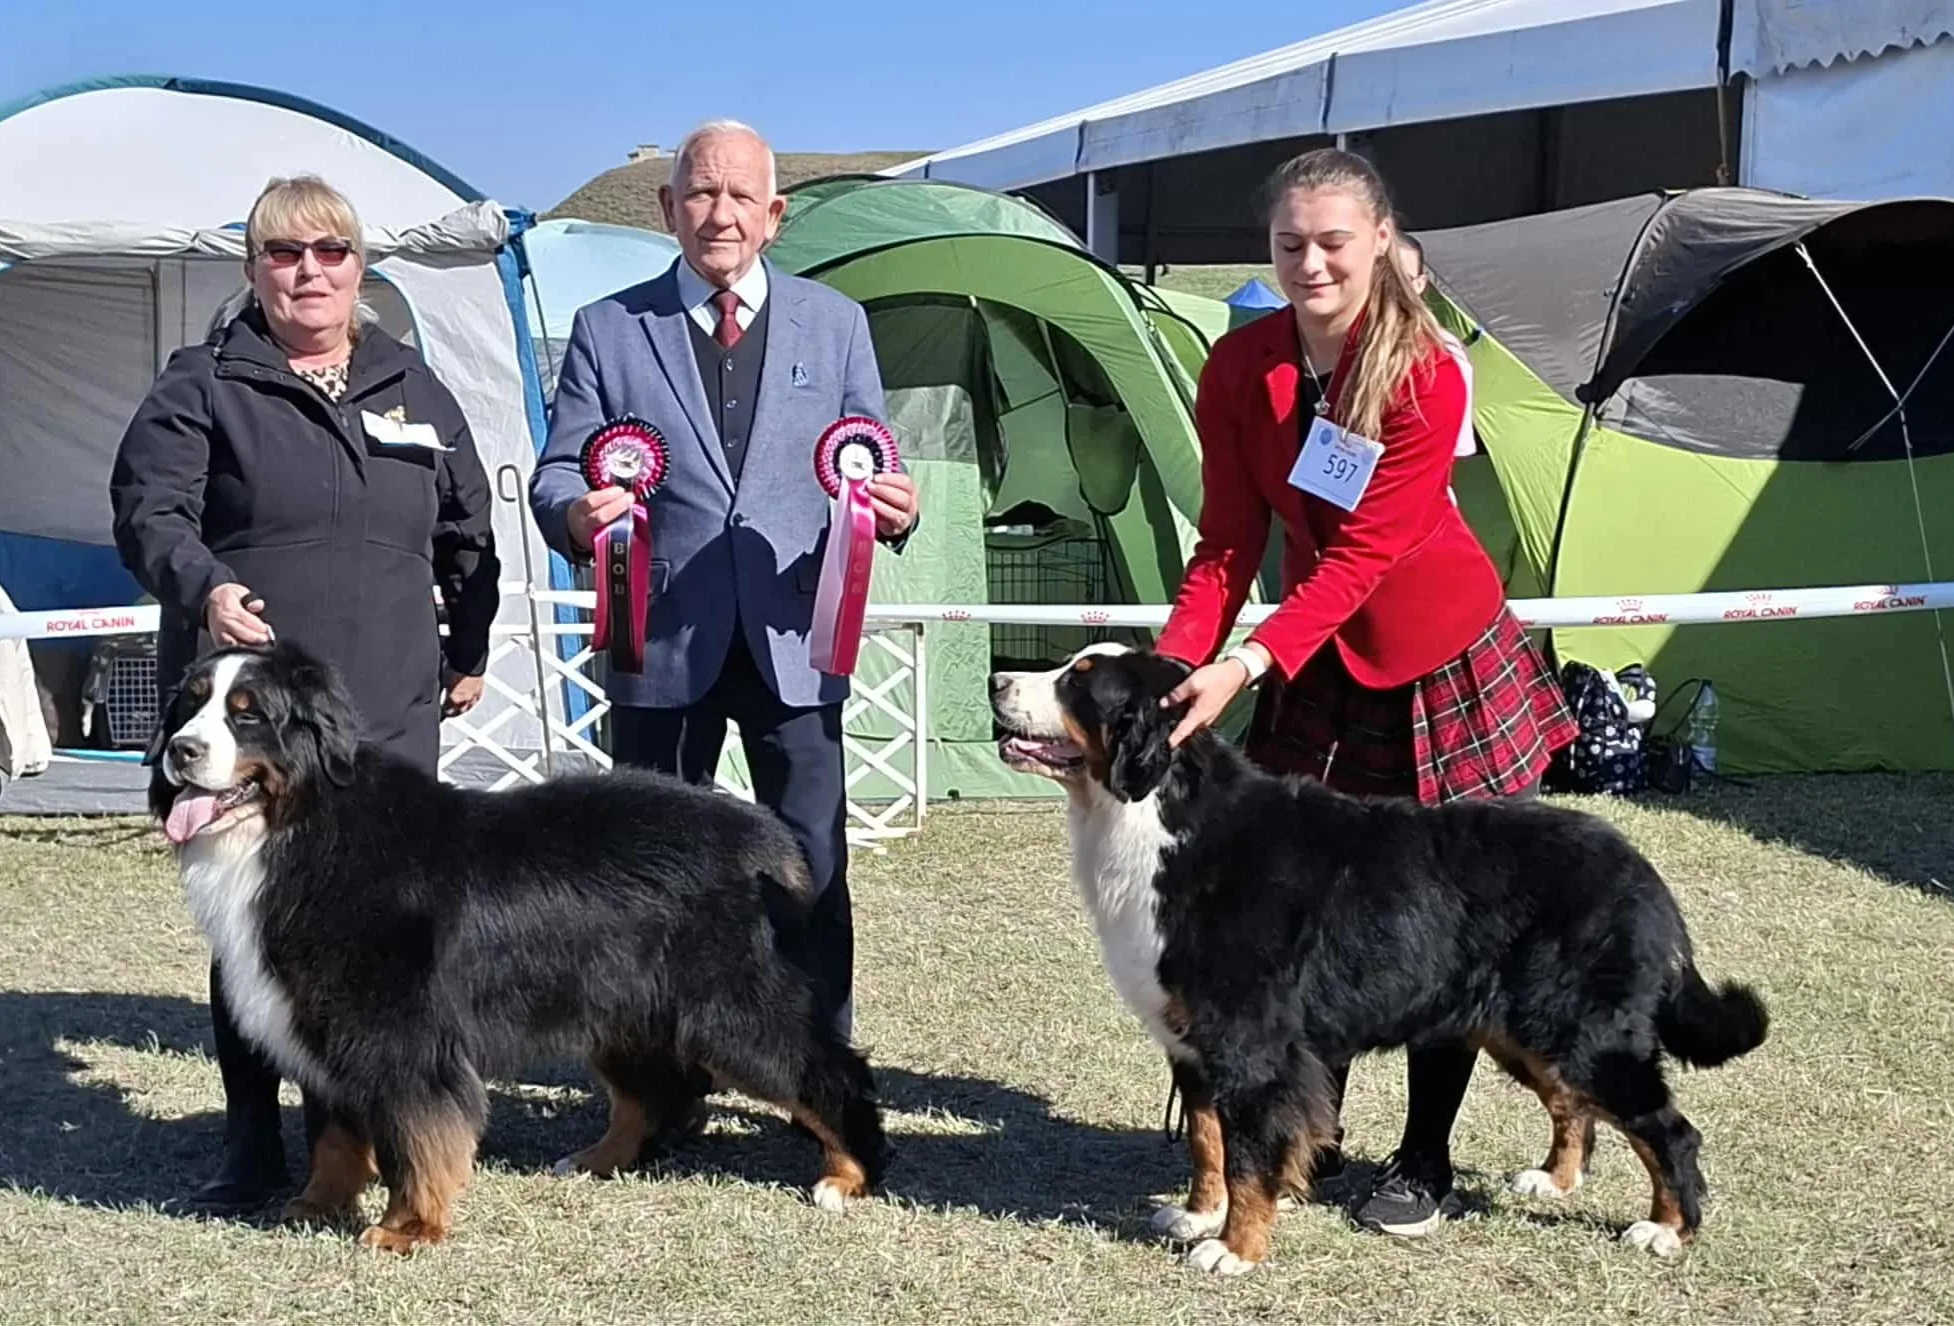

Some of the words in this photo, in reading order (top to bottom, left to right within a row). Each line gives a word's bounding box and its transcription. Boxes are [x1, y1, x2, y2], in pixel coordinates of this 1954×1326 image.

[1322, 454, 1359, 483] 597
[1853, 600, 1887, 609] ROYAL
[1889, 595, 1927, 608] CANIN
[1592, 615, 1626, 624] ROYAL
[1629, 613, 1668, 623] CANIN
[1723, 609, 1756, 618] ROYAL
[1760, 606, 1798, 617] CANIN
[46, 619, 88, 633] ROYAL
[91, 616, 135, 630] CANIN
